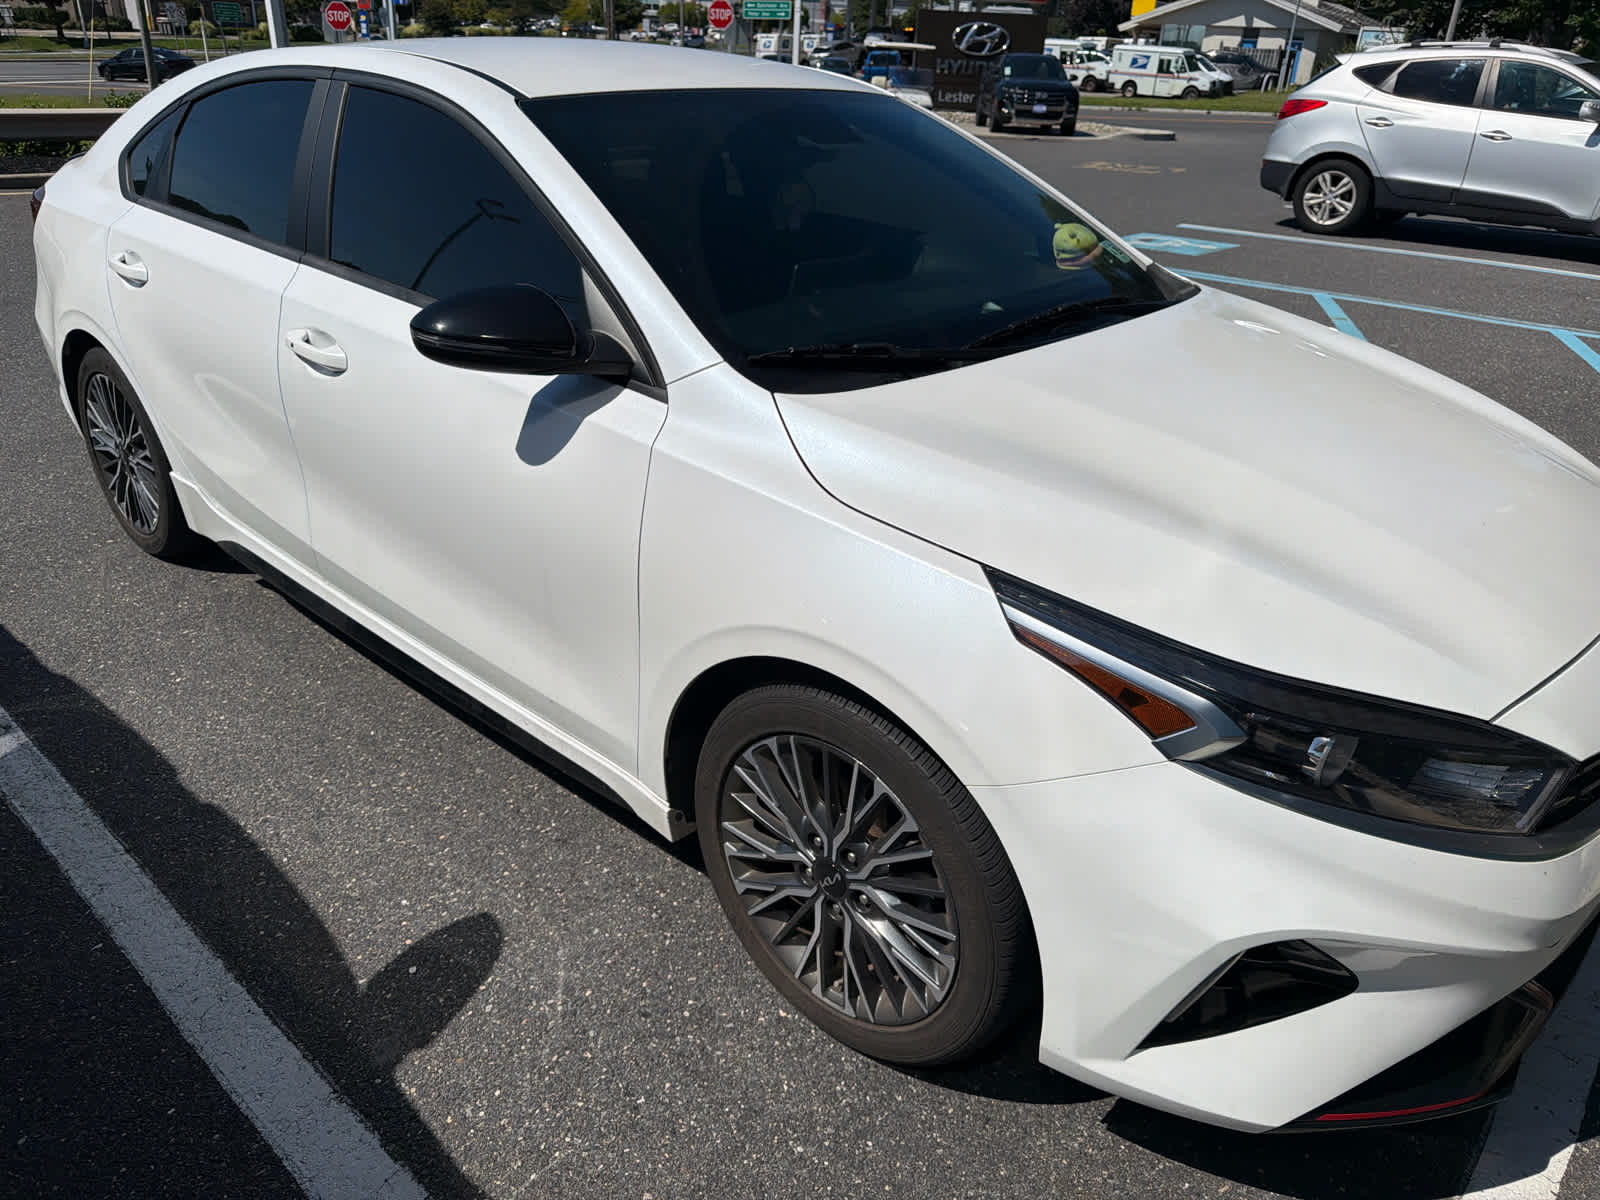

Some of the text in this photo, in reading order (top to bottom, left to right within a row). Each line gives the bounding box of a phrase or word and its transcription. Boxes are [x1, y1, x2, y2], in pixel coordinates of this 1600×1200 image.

[327, 10, 350, 22] STOP
[709, 8, 732, 20] STOP
[938, 89, 975, 104] Lester
